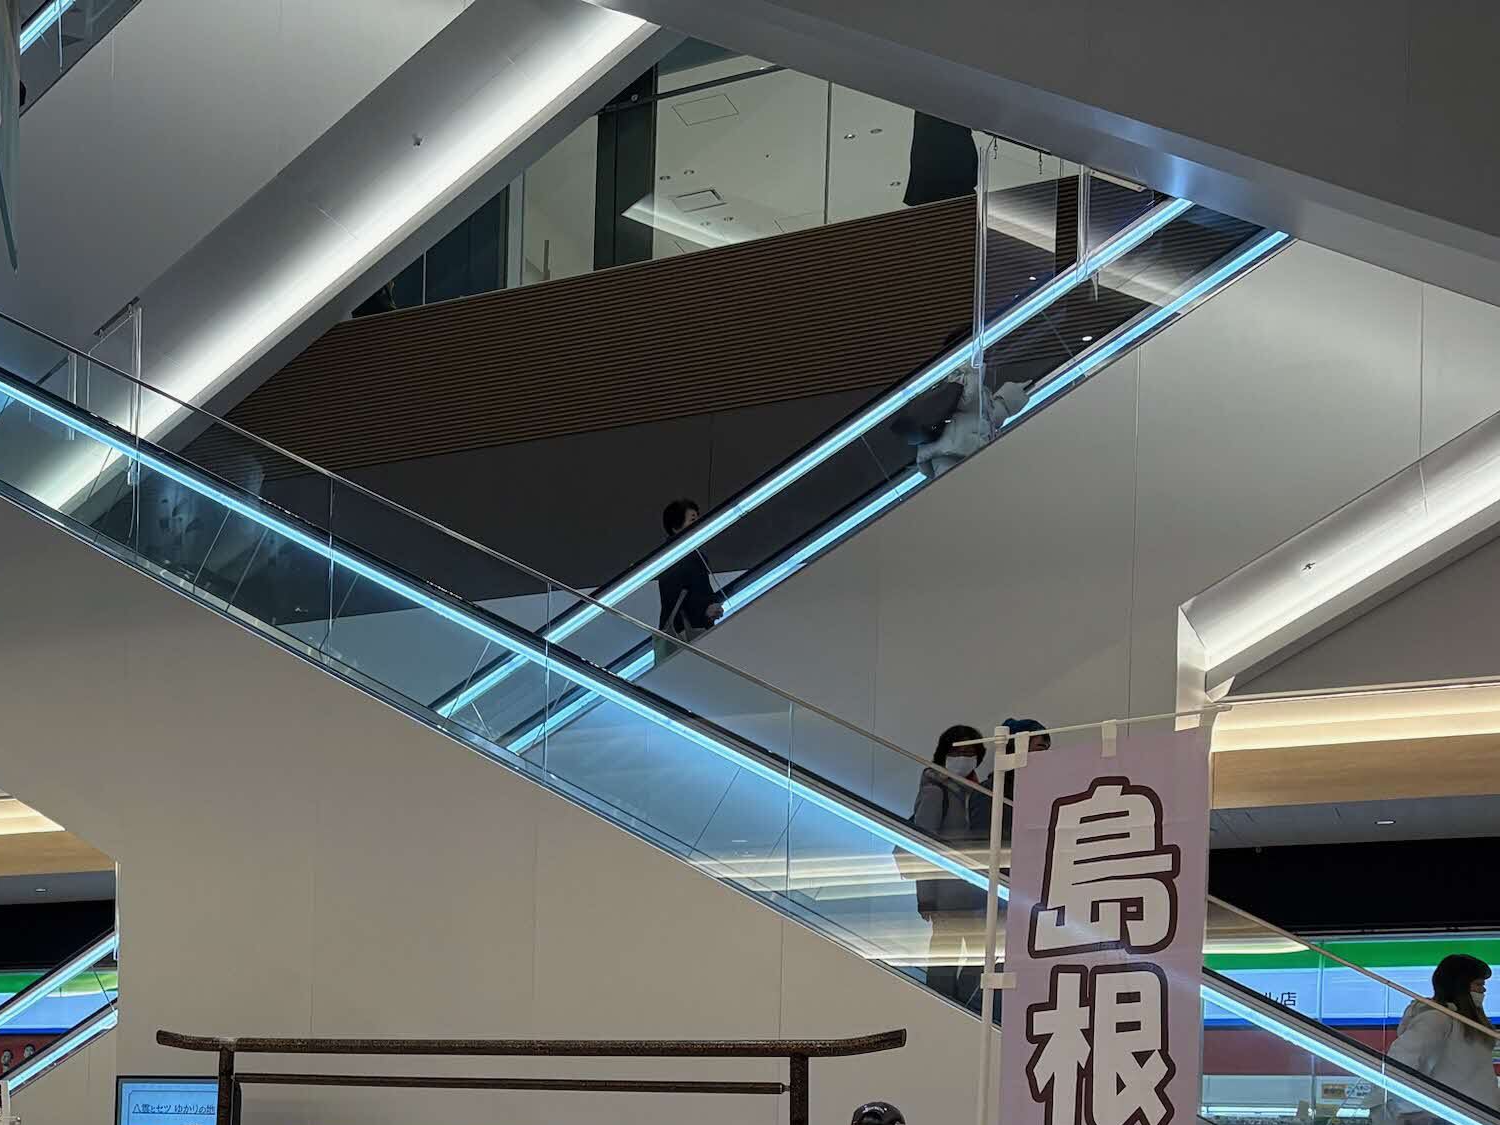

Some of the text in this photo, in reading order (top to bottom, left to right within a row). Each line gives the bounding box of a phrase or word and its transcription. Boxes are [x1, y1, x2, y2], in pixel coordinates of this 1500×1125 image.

[132, 1103, 216, 1115] 八雲とセツ ゆかりの地
